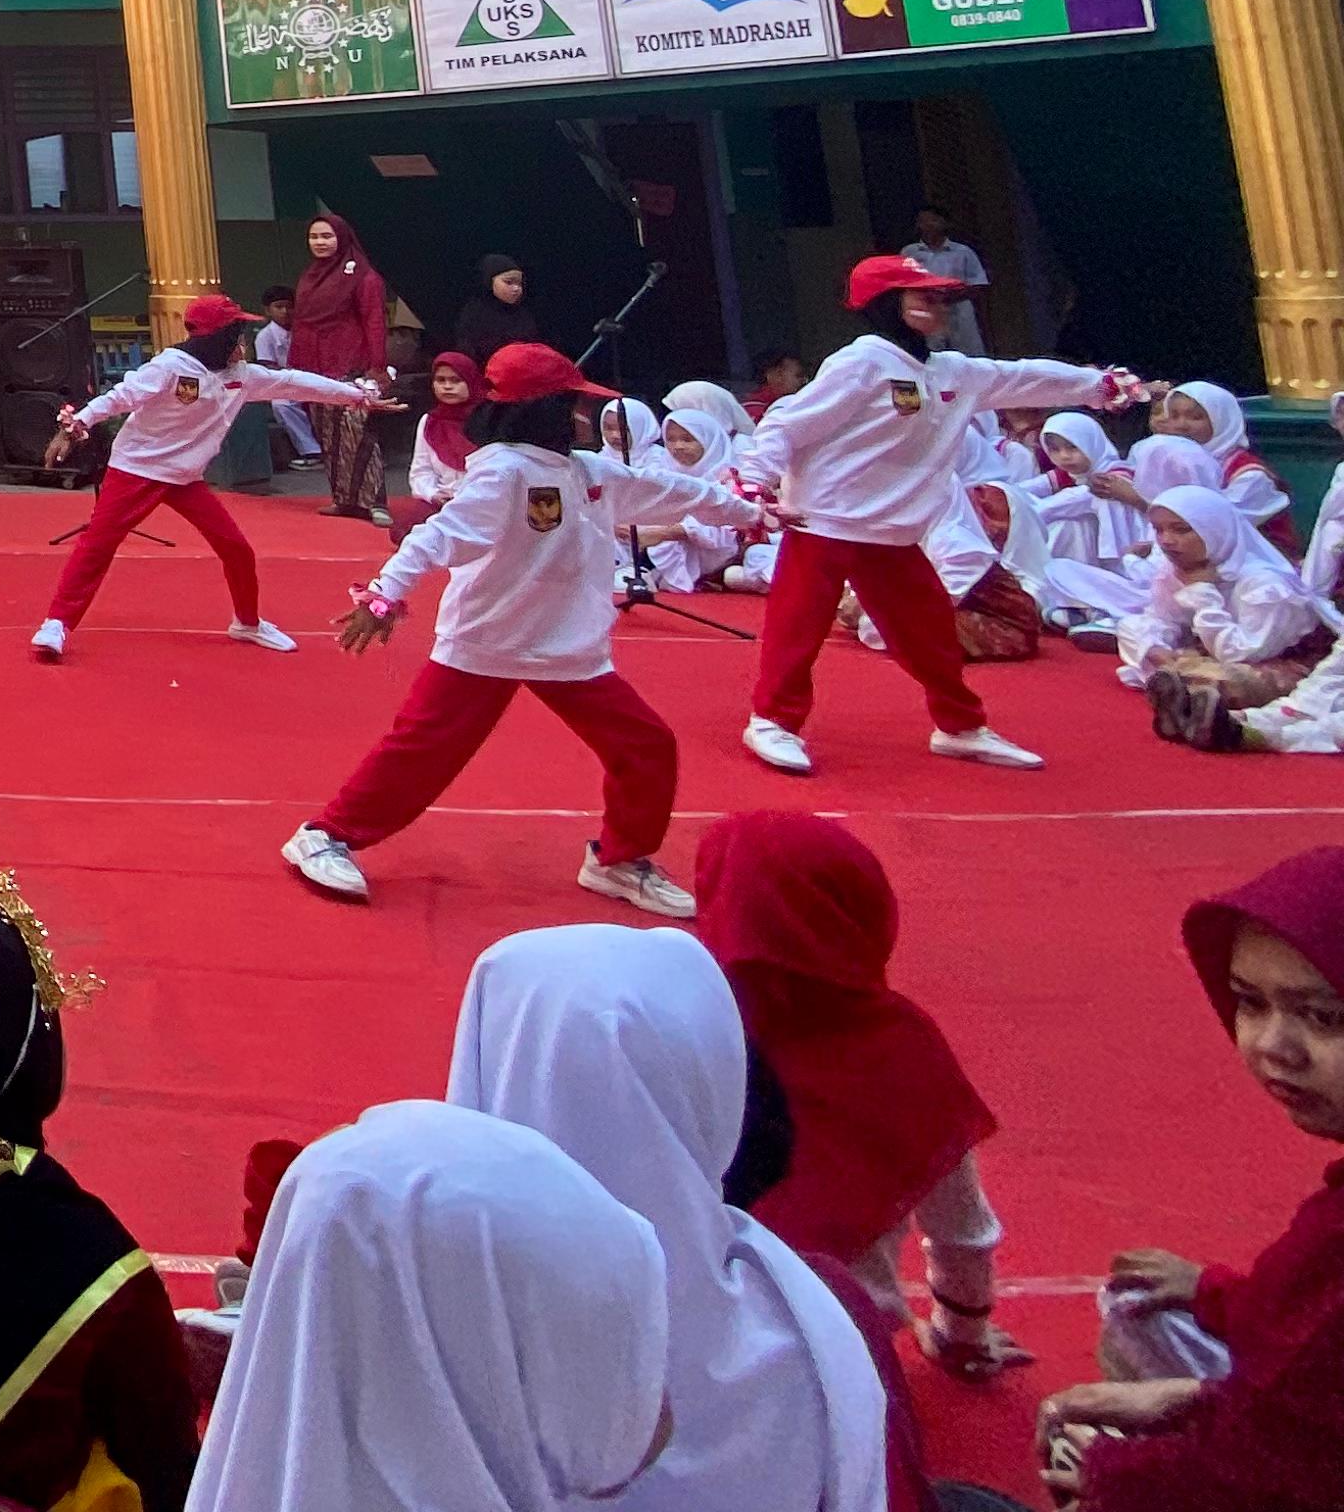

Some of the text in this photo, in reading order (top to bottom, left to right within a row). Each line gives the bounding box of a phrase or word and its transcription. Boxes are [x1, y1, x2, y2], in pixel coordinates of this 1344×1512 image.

[487, 2, 534, 23] UKS
[635, 19, 812, 53] KOMITE MADRASAH
[275, 48, 362, 70] N U
[444, 47, 587, 71] TIM PELAKSANA
